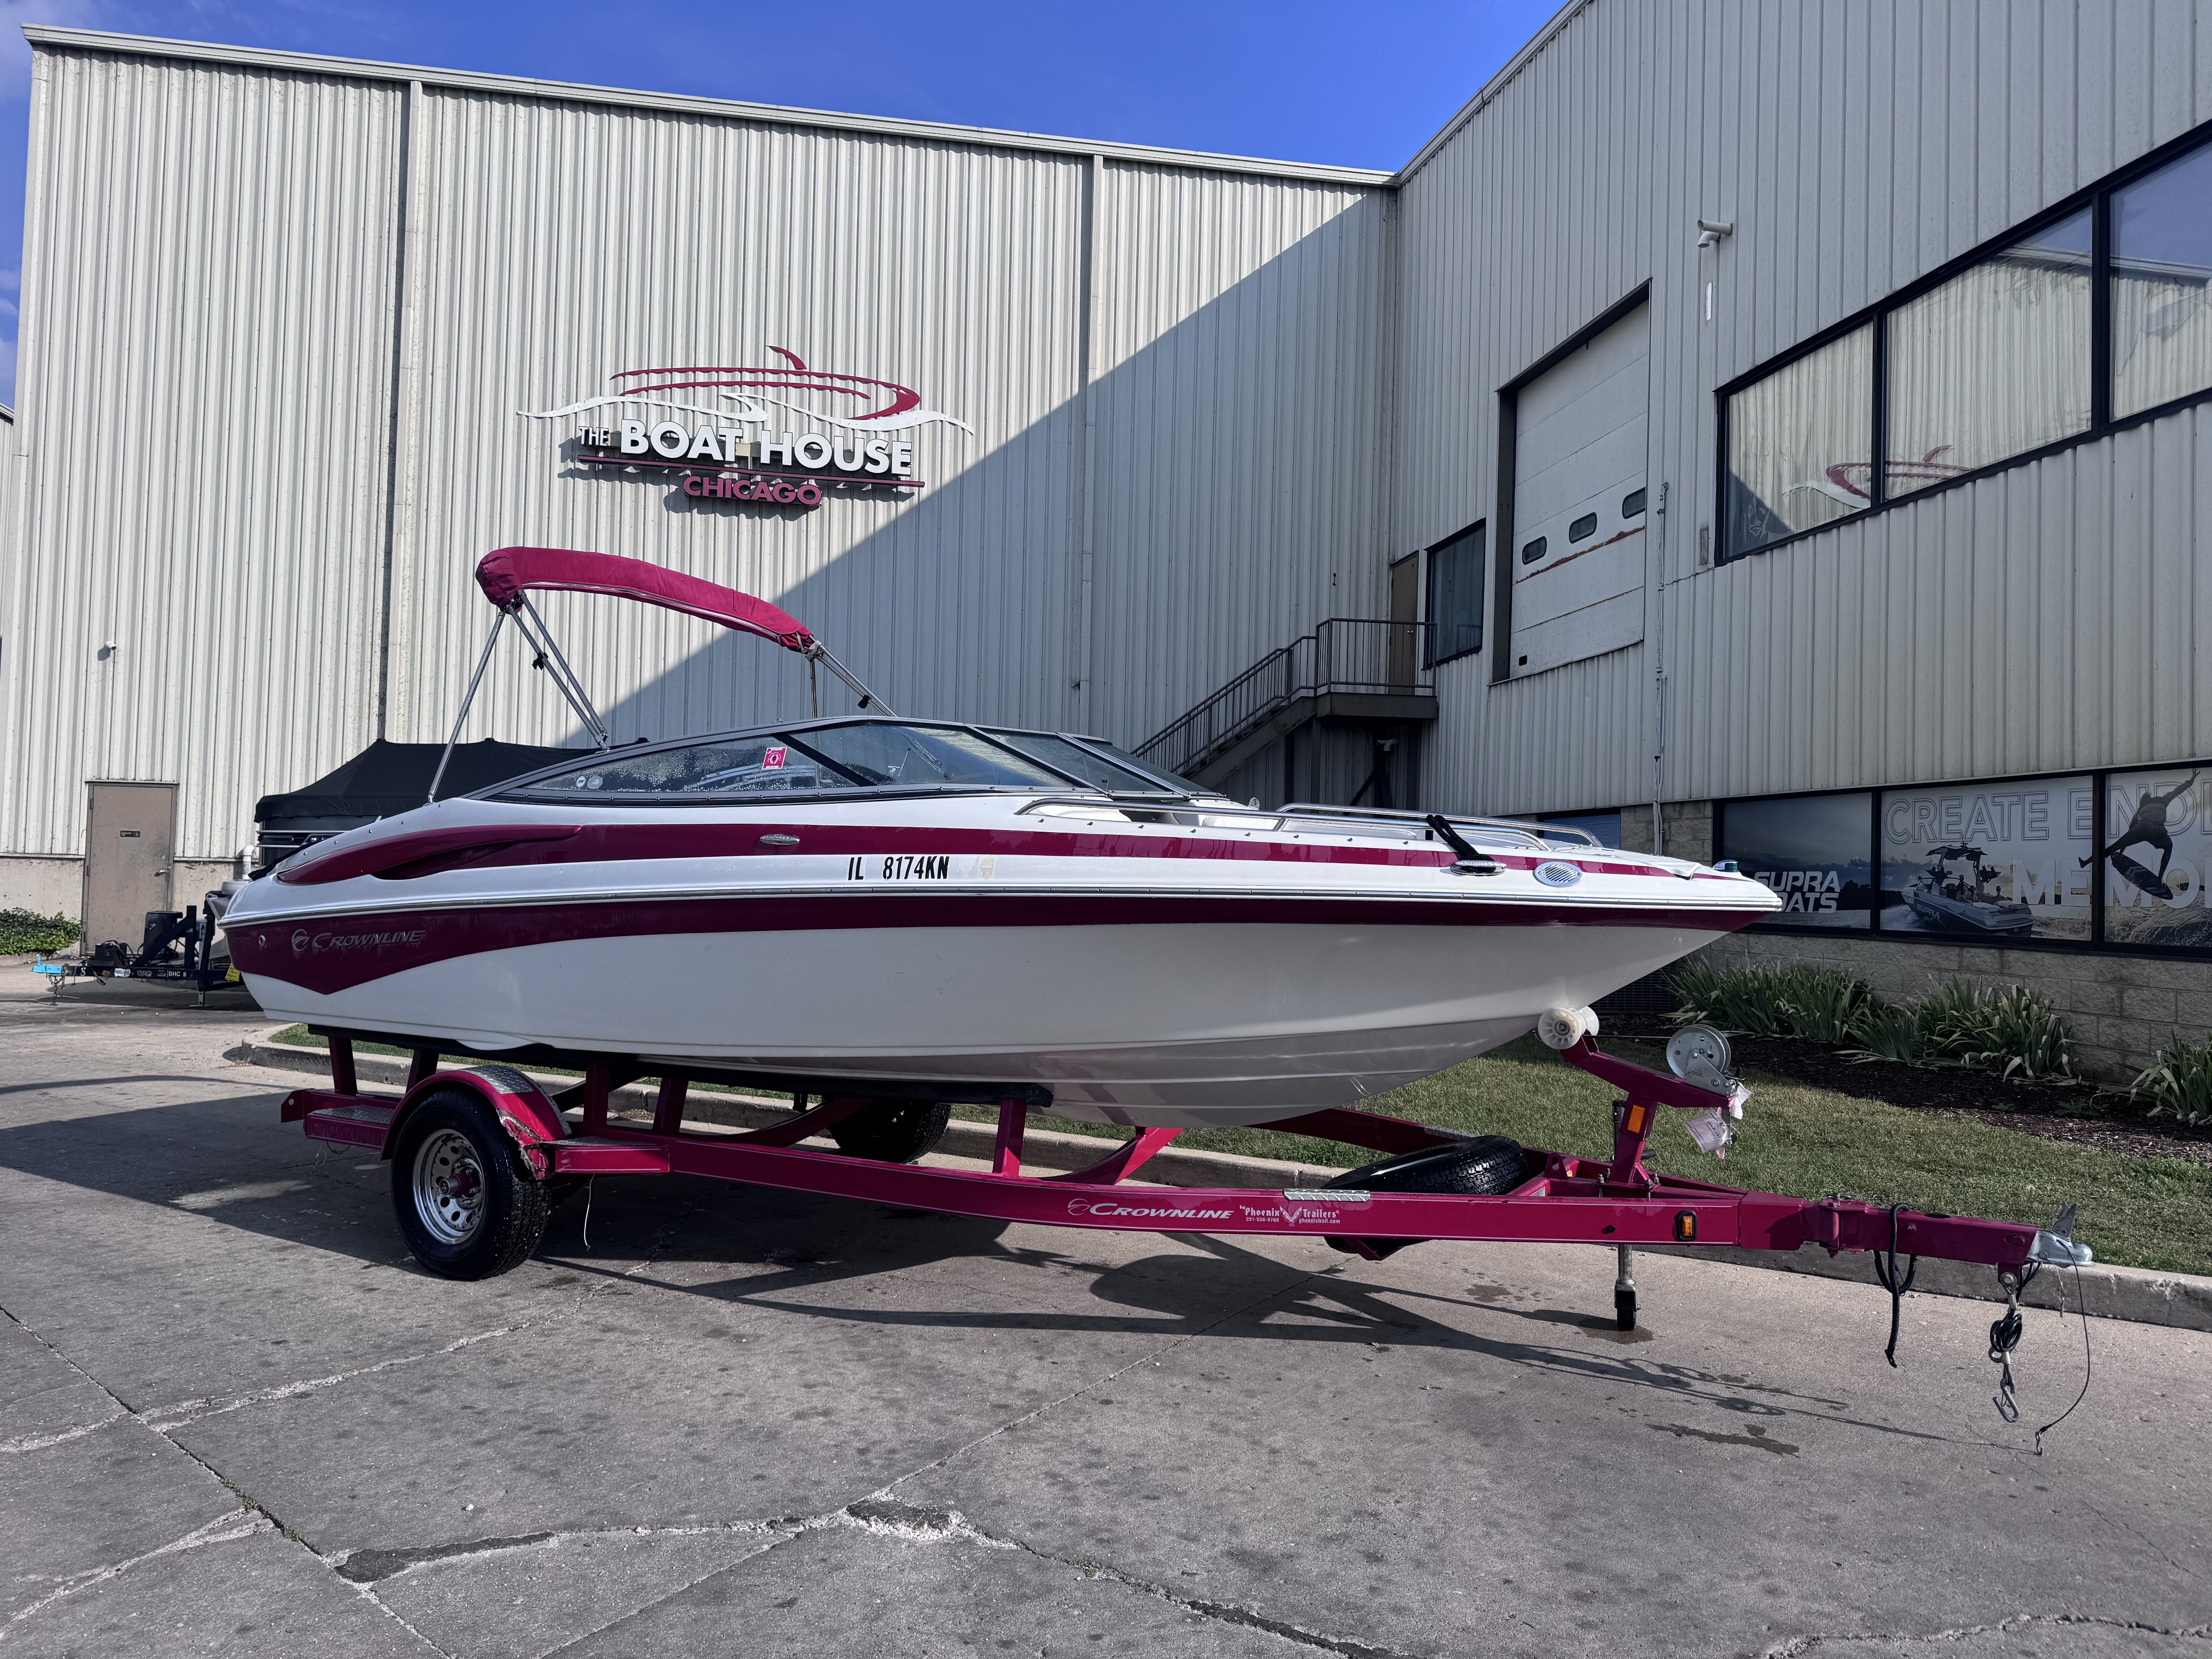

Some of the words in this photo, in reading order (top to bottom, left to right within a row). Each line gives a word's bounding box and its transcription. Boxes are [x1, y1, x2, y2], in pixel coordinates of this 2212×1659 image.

[579, 426, 609, 447] THE
[621, 419, 743, 462] BOAT
[760, 429, 912, 475] HOUSE
[683, 476, 822, 505] CHICAGO
[1884, 791, 2049, 844] CREATE
[848, 857, 864, 881] IL
[883, 856, 950, 879] 8174KN
[1754, 871, 1841, 892] SUPRA
[2012, 856, 2212, 909] MEMO
[1777, 892, 1839, 914] ATS
[1916, 903, 1941, 920] SUPRA
[312, 930, 426, 949] CROWNLINE
[1089, 1203, 1234, 1219] CROWNLINE
[1245, 1207, 1279, 1216] Phoenix
[1303, 1209, 1336, 1218] Trailers
